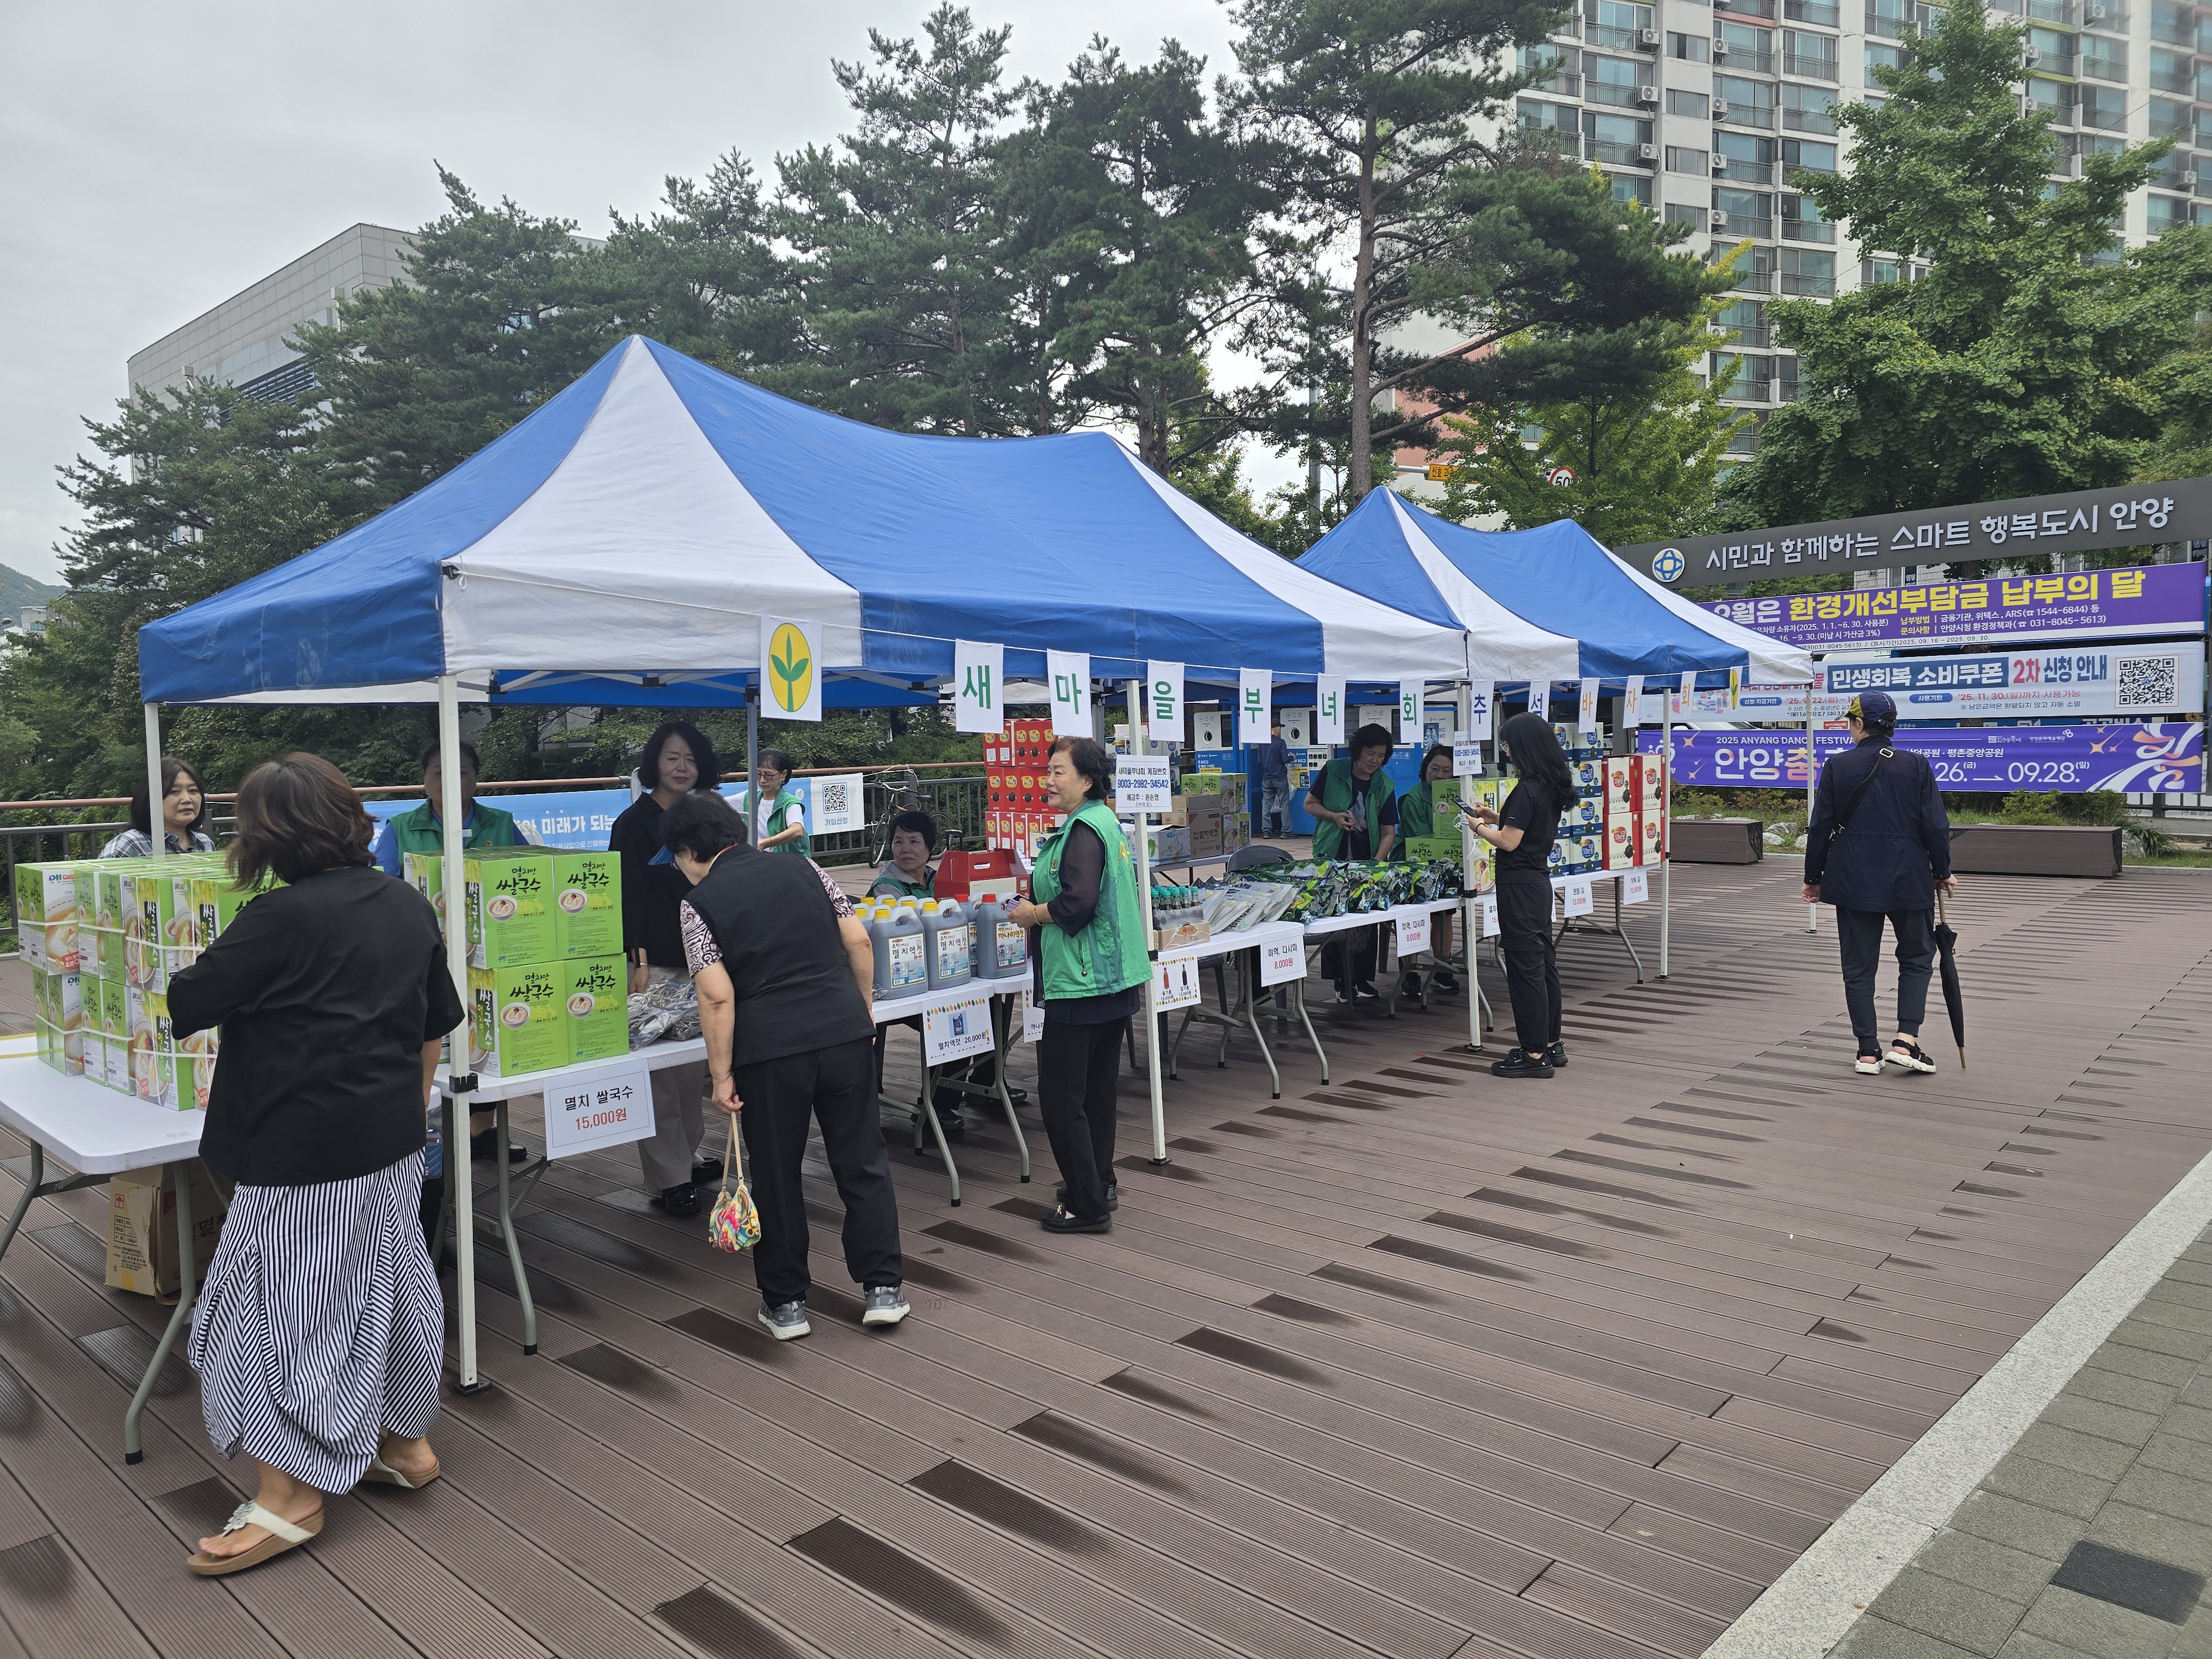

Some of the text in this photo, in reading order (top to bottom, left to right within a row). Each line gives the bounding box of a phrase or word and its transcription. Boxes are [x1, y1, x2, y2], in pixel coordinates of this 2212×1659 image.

[1432, 466, 1442, 477] 신호
[1555, 476, 1571, 487] 50
[1706, 497, 2174, 571] 시민과 함께하는 스마트 행복도시 안양
[1790, 583, 1989, 621] 환경개선부담금
[2002, 574, 2098, 607] 납부의
[2112, 571, 2146, 599] 달
[1901, 615, 1930, 625] 납부방법
[1940, 613, 1974, 623] 금융기관,
[2036, 604, 2089, 615] 1544-6844)
[2090, 604, 2100, 613] 등
[1864, 618, 1889, 628] 사용분)
[1901, 625, 1930, 635] 문의사항
[1940, 623, 1971, 633] 안양시청
[1843, 630, 1865, 639] 가산금
[1832, 666, 1912, 690] 민생회복
[1916, 662, 2004, 686] 소비쿠폰
[2013, 658, 2041, 684] 2차
[2043, 656, 2073, 683] 신청
[2077, 654, 2108, 682] 안내
[1991, 690, 2040, 700] 30.(일)까지
[2043, 689, 2081, 699] 사용가능
[1716, 736, 1739, 744] 2025
[1740, 736, 1780, 744] ANYANG
[1782, 737, 1813, 745] DANC
[1947, 748, 2004, 758] 평촌중앙공원
[1118, 767, 1145, 775] 새마을부녀회
[1118, 779, 1169, 789] 9003-2982-34542
[541, 815, 586, 834] 미래가
[825, 817, 848, 826] 가입신청
[1199, 829, 1219, 839] 멸치액젓
[1411, 848, 1432, 858] 쌀국수
[512, 866, 537, 878] 멸치맛
[582, 861, 606, 872] 멸치맛
[496, 877, 541, 895] 쌀국수
[567, 872, 609, 889] 쌀국수
[468, 881, 479, 942] 쌀국수
[1413, 919, 1425, 928] 다시마
[998, 930, 1024, 939] 까나리액젓
[1406, 932, 1421, 942] 8,000원
[941, 936, 967, 951] 멸치액젓
[1282, 943, 1298, 953] 다시마
[893, 945, 922, 959] 멸치액젓
[1274, 957, 1293, 969] 8,000원
[589, 964, 613, 975] 멸치맛
[525, 972, 550, 984] 멸치맛
[575, 974, 616, 993] 쌀국수
[509, 984, 554, 1002] 쌀국수
[479, 989, 493, 1050] 쌀국수
[938, 1031, 987, 1050] 멸치액젓 20,000원
[565, 1086, 633, 1111] 멸치 쌀국수
[575, 1107, 627, 1130] 15,000원
